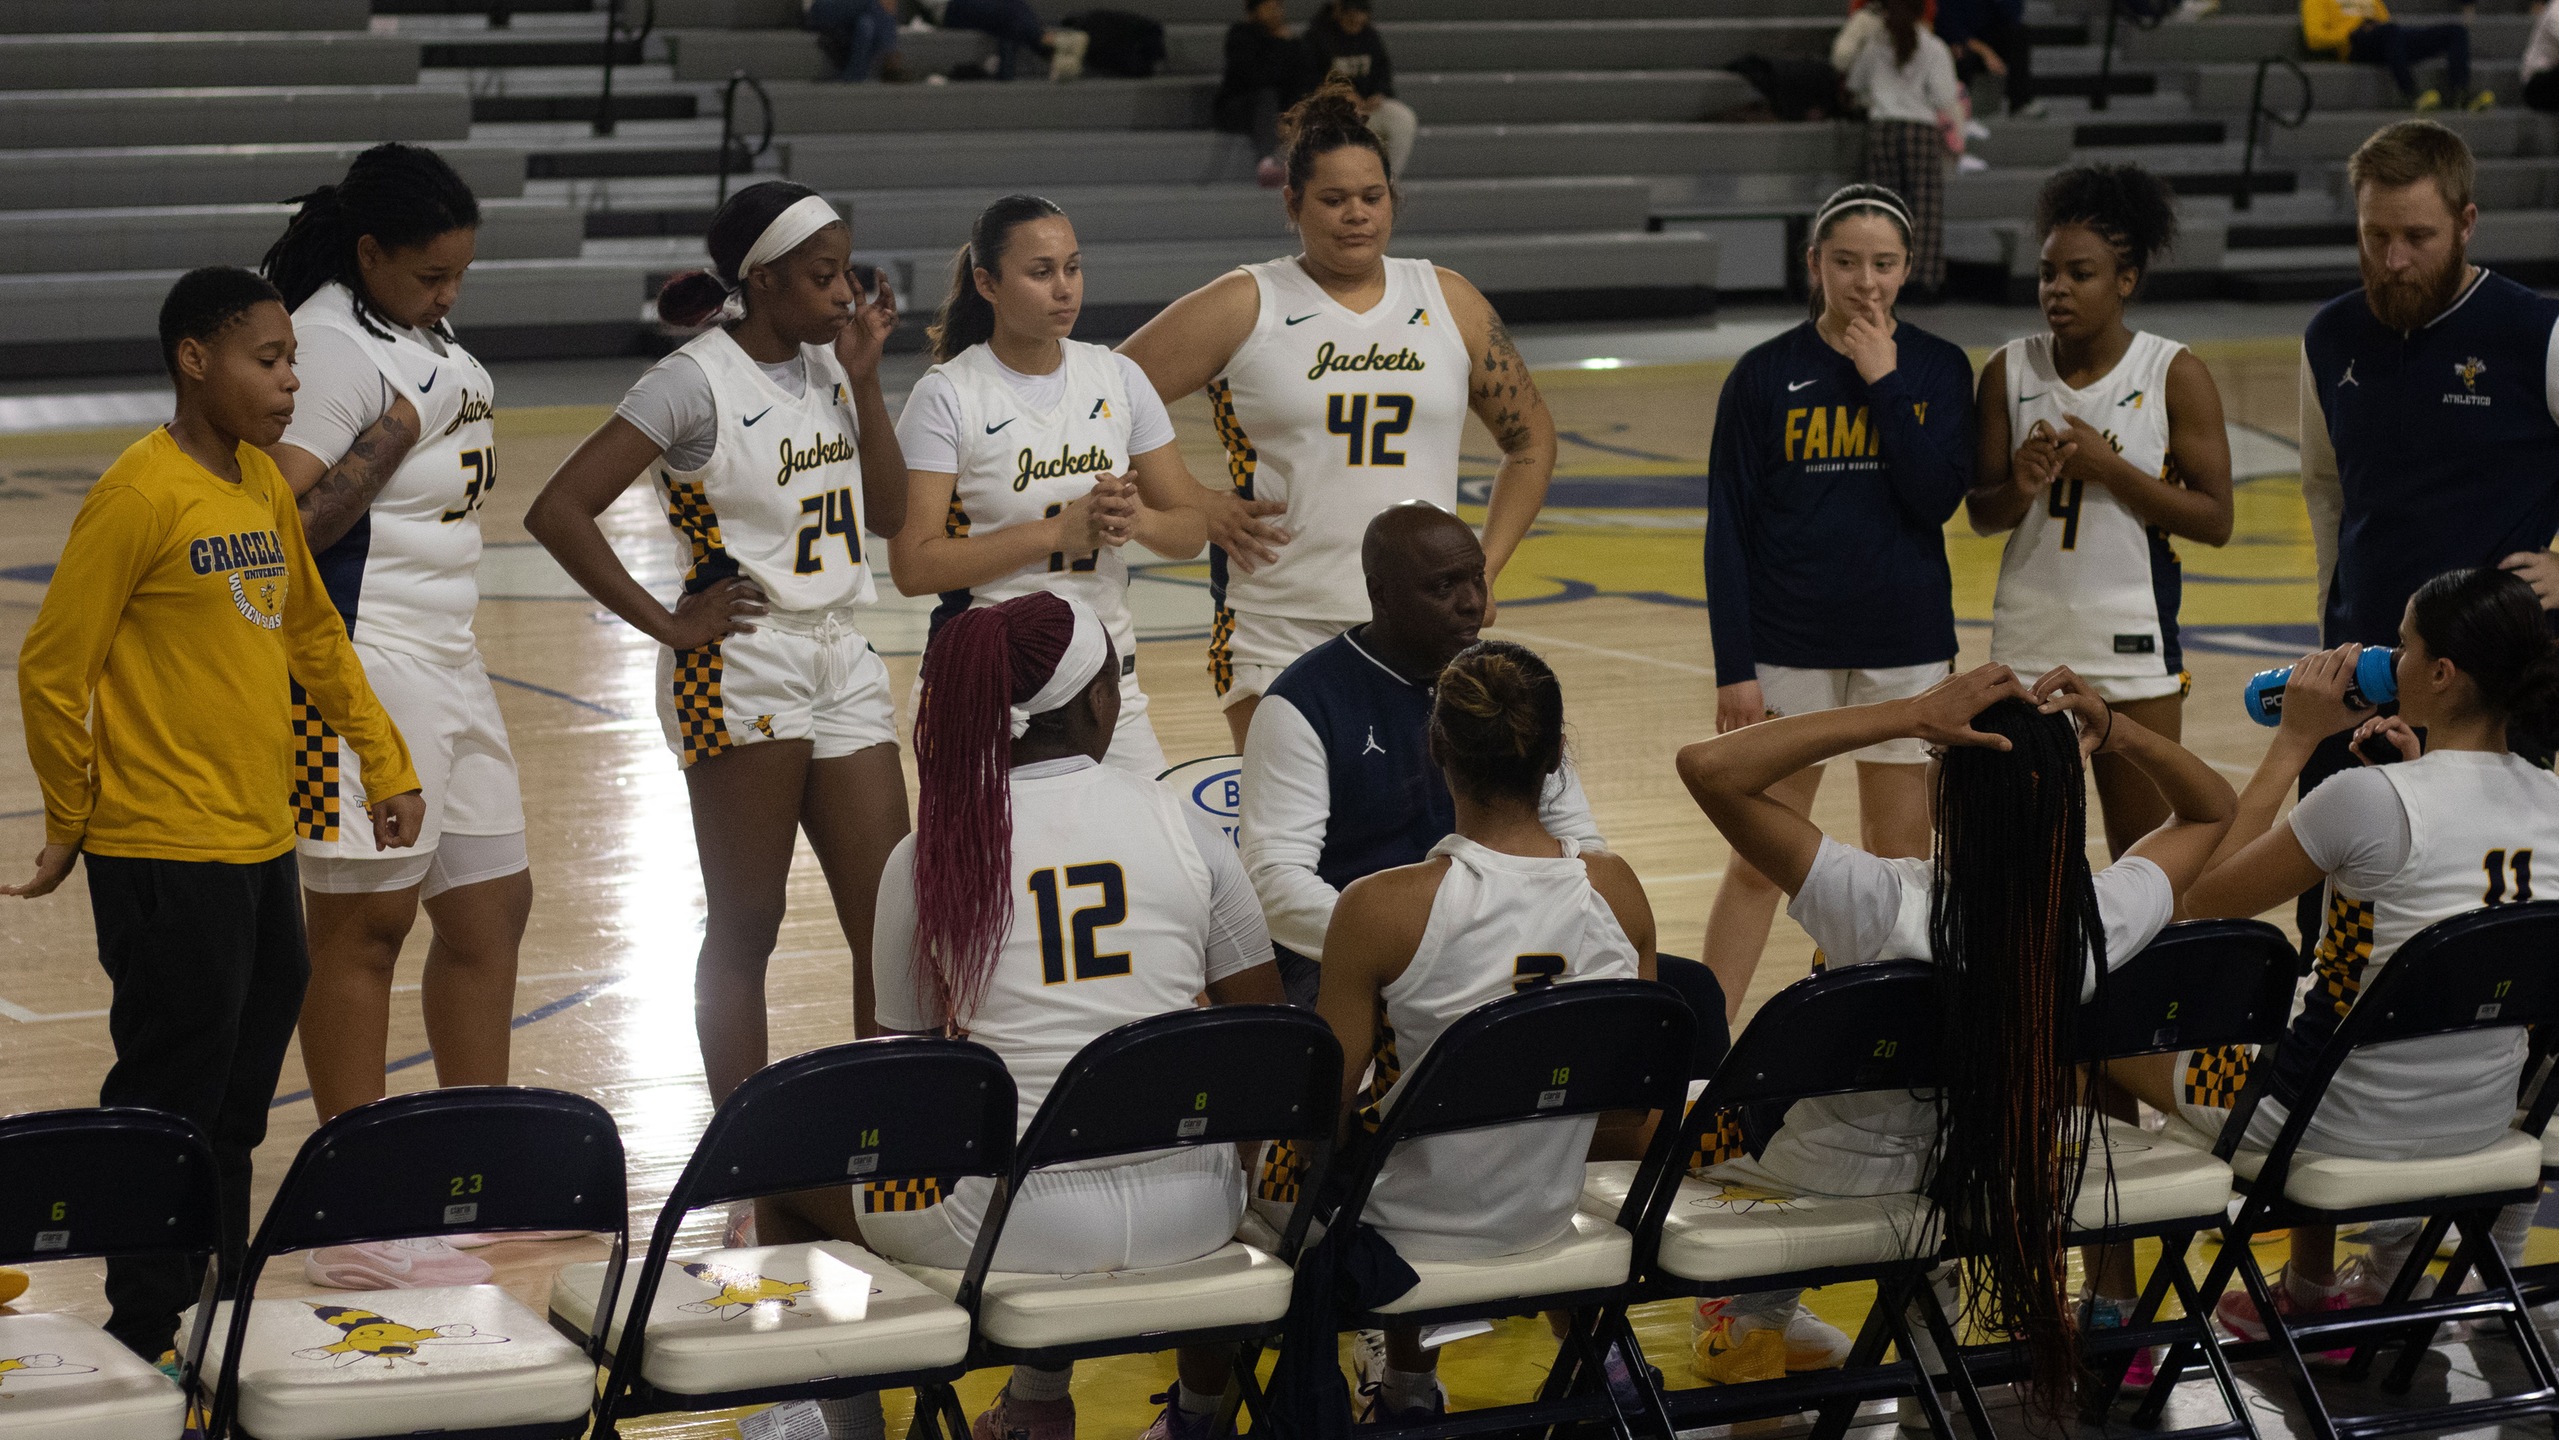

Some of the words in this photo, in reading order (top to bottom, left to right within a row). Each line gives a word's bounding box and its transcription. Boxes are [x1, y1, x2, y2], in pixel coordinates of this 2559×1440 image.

[1308, 341, 1425, 380] Jackets
[2442, 393, 2492, 407] ATHLETICS
[1326, 393, 1415, 467] 42
[1784, 401, 1929, 462] FAMIY
[777, 432, 854, 486] Jackets
[1013, 443, 1113, 492] Jackets
[2050, 479, 2084, 551] 4
[793, 486, 861, 575] 24
[1027, 860, 1132, 986] 12
[2494, 980, 2513, 999] 17
[2166, 1001, 2179, 1020] 2
[1873, 1039, 1898, 1059] 20
[1551, 1067, 1570, 1086] 18
[1194, 1091, 1208, 1111] 8
[861, 1128, 880, 1149] 14
[450, 1173, 483, 1196] 23
[52, 1201, 66, 1221] 6
